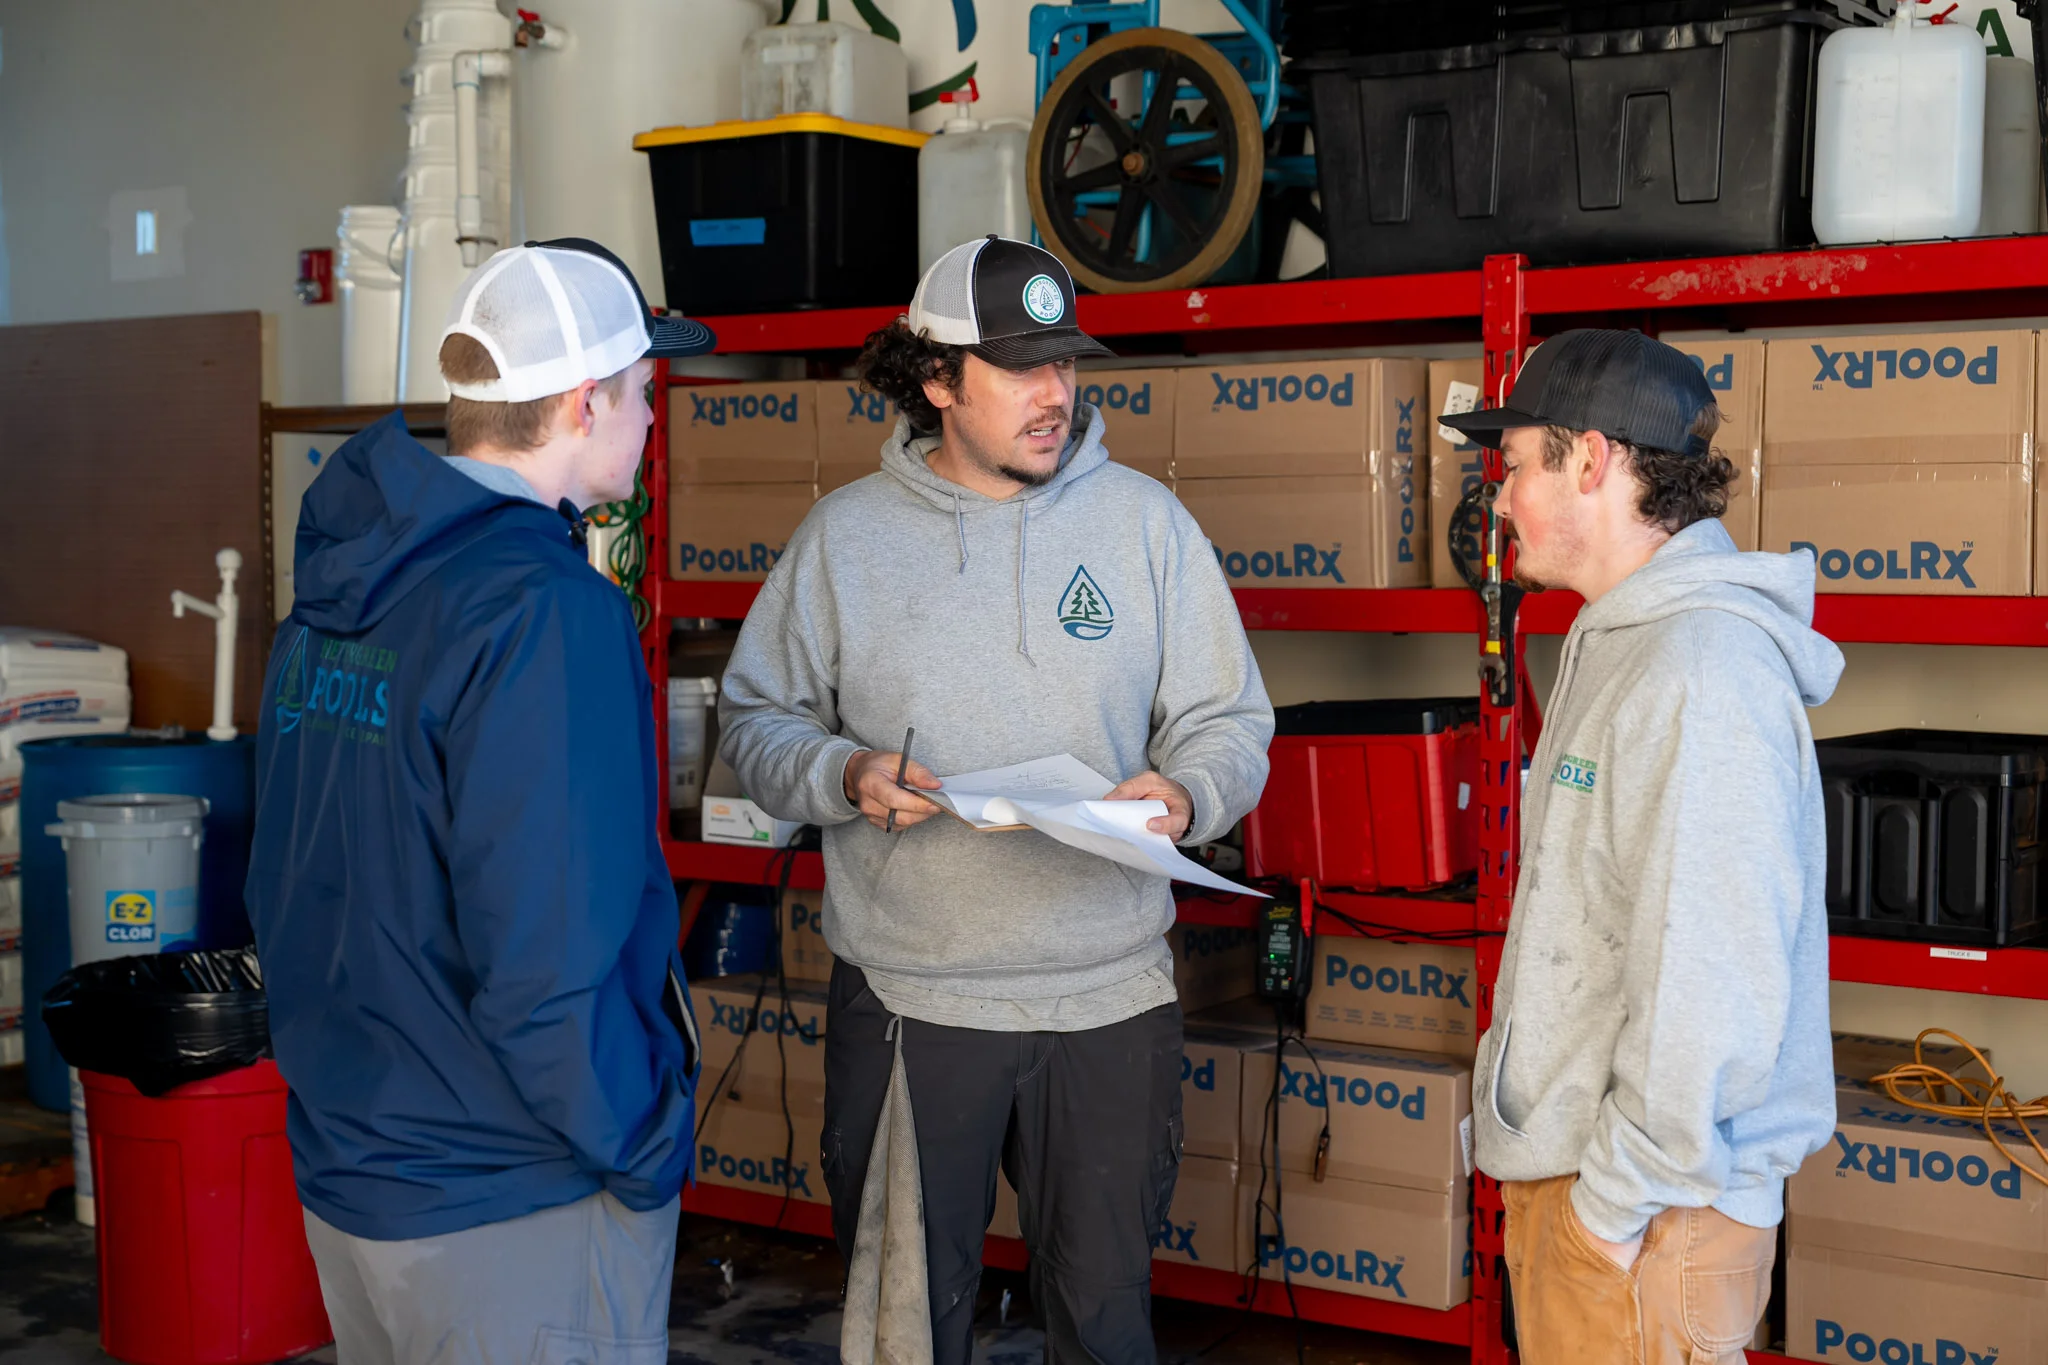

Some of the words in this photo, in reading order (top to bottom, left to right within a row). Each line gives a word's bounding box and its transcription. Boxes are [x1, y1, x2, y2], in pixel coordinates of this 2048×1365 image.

[1559, 763, 1596, 787] OLS
[114, 902, 148, 918] E-Z
[108, 927, 153, 940] CLOR
